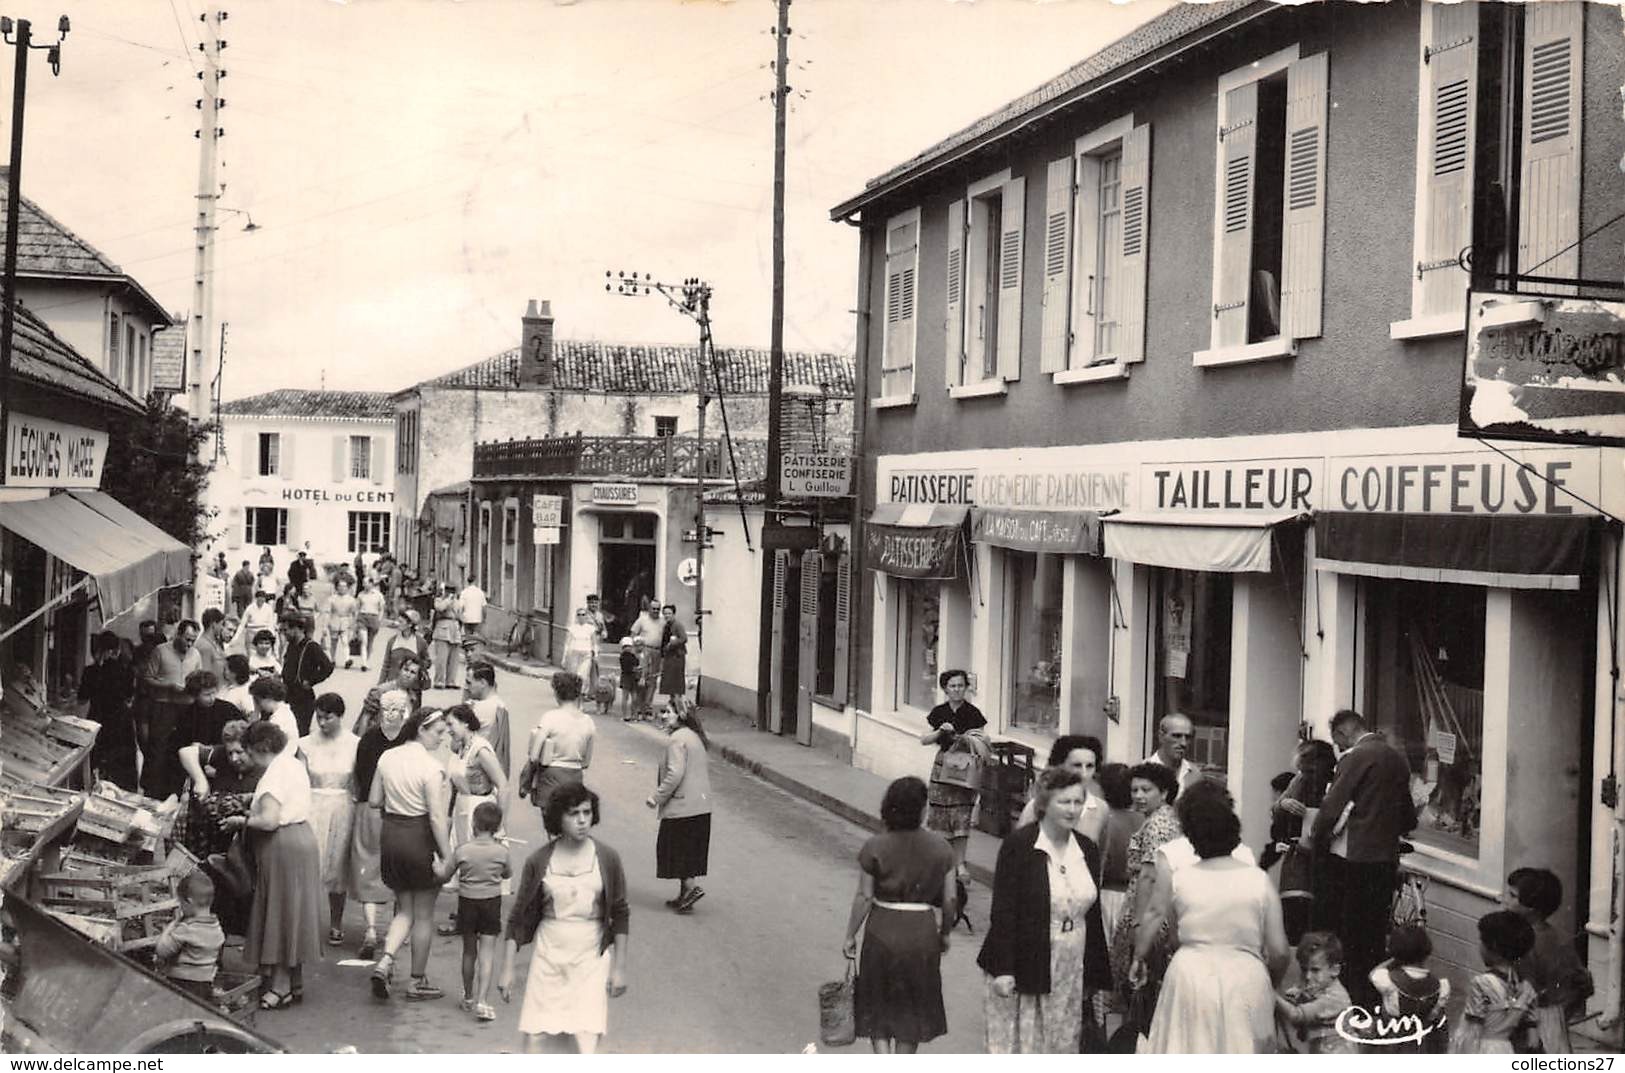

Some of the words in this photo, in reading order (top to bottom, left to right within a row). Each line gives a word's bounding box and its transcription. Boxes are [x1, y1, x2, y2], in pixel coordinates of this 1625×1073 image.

[11, 423, 61, 478] LÉGUMES
[784, 468, 846, 480] CONFISERIE
[891, 474, 974, 504] PATISSERIE
[1046, 472, 1130, 507] PARISIENNE
[1154, 467, 1312, 511] TAILLEUR
[1340, 461, 1573, 514] COIFFEUSE
[282, 489, 330, 501] HOTEL
[593, 487, 637, 500] CHAUSSURES
[536, 512, 557, 523] BAR
[880, 536, 935, 569] PATISSERIE
